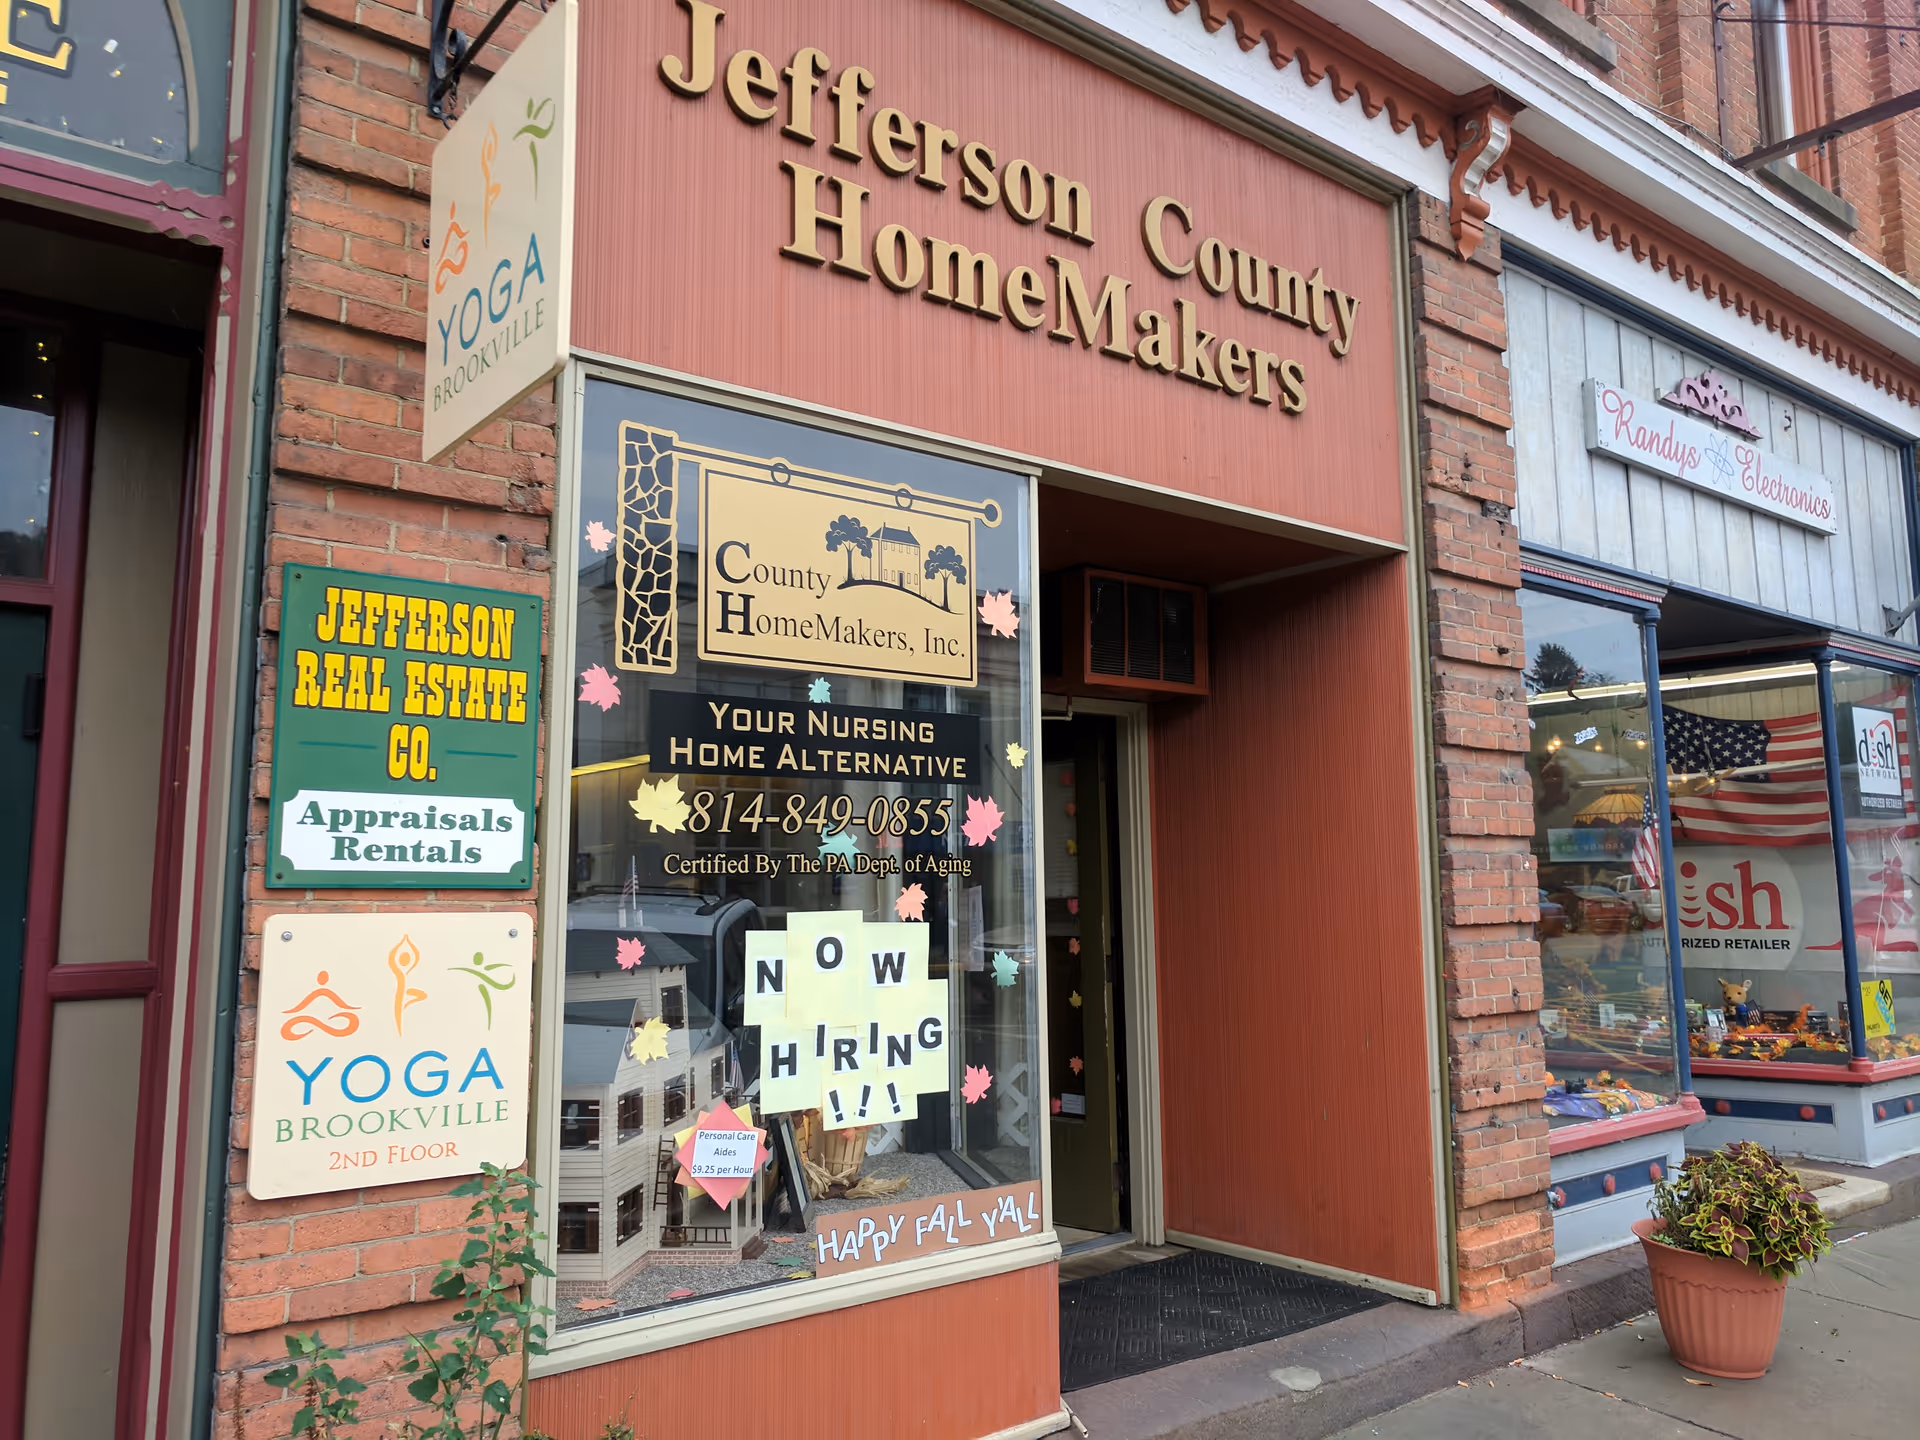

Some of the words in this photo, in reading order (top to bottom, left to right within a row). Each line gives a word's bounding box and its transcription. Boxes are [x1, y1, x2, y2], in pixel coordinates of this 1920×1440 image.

[658, 0, 1095, 247] Jefferson
[1141, 196, 1361, 358] County
[438, 233, 545, 367] YOGA
[779, 160, 1308, 417] HomeMakers
[433, 298, 545, 412] BROOKVILLE
[1602, 389, 1700, 477] Randys
[1735, 444, 1832, 520] Electronics
[715, 541, 831, 599] County
[315, 585, 516, 661] JEFFERSON
[716, 590, 915, 657] HomeMakers,
[924, 628, 965, 658] Inc.
[293, 649, 392, 713] REAL
[402, 659, 528, 723] ESTATE
[386, 722, 438, 782] CO.
[708, 702, 795, 735] YOUR
[808, 710, 935, 744] NURSING
[1858, 728, 1895, 770] dish
[670, 737, 765, 770] HOME
[776, 743, 967, 779] ALTERNATIVE
[1860, 767, 1898, 780] NETWORK
[297, 800, 513, 833] Appraisals
[687, 790, 953, 836] 814-849-0855
[330, 836, 482, 864] Rentals
[663, 853, 750, 876] Certified
[754, 855, 781, 878] By
[787, 854, 820, 874] The
[825, 856, 852, 874] PA
[855, 855, 900, 877] Dept.
[904, 854, 923, 873] of
[925, 856, 972, 877] Aging
[1645, 860, 1790, 931] ish
[757, 936, 905, 994] NOW
[1725, 939, 1790, 950] RETAILER
[286, 1048, 504, 1106] YOGA
[770, 1017, 943, 1079] HIRING
[275, 1100, 509, 1143] BROOKVILLE
[699, 1131, 735, 1140] Personal
[737, 1132, 756, 1141] Care
[328, 1150, 378, 1171] 2ND
[387, 1141, 460, 1164] FLOOR
[692, 1165, 715, 1174] $9.25
[717, 1167, 731, 1175] per
[733, 1165, 754, 1174] Hour
[713, 1148, 737, 1157] Aides
[817, 1214, 905, 1264] HAPPY
[915, 1199, 972, 1247] FALL
[981, 1191, 1040, 1238] Y'ALL
